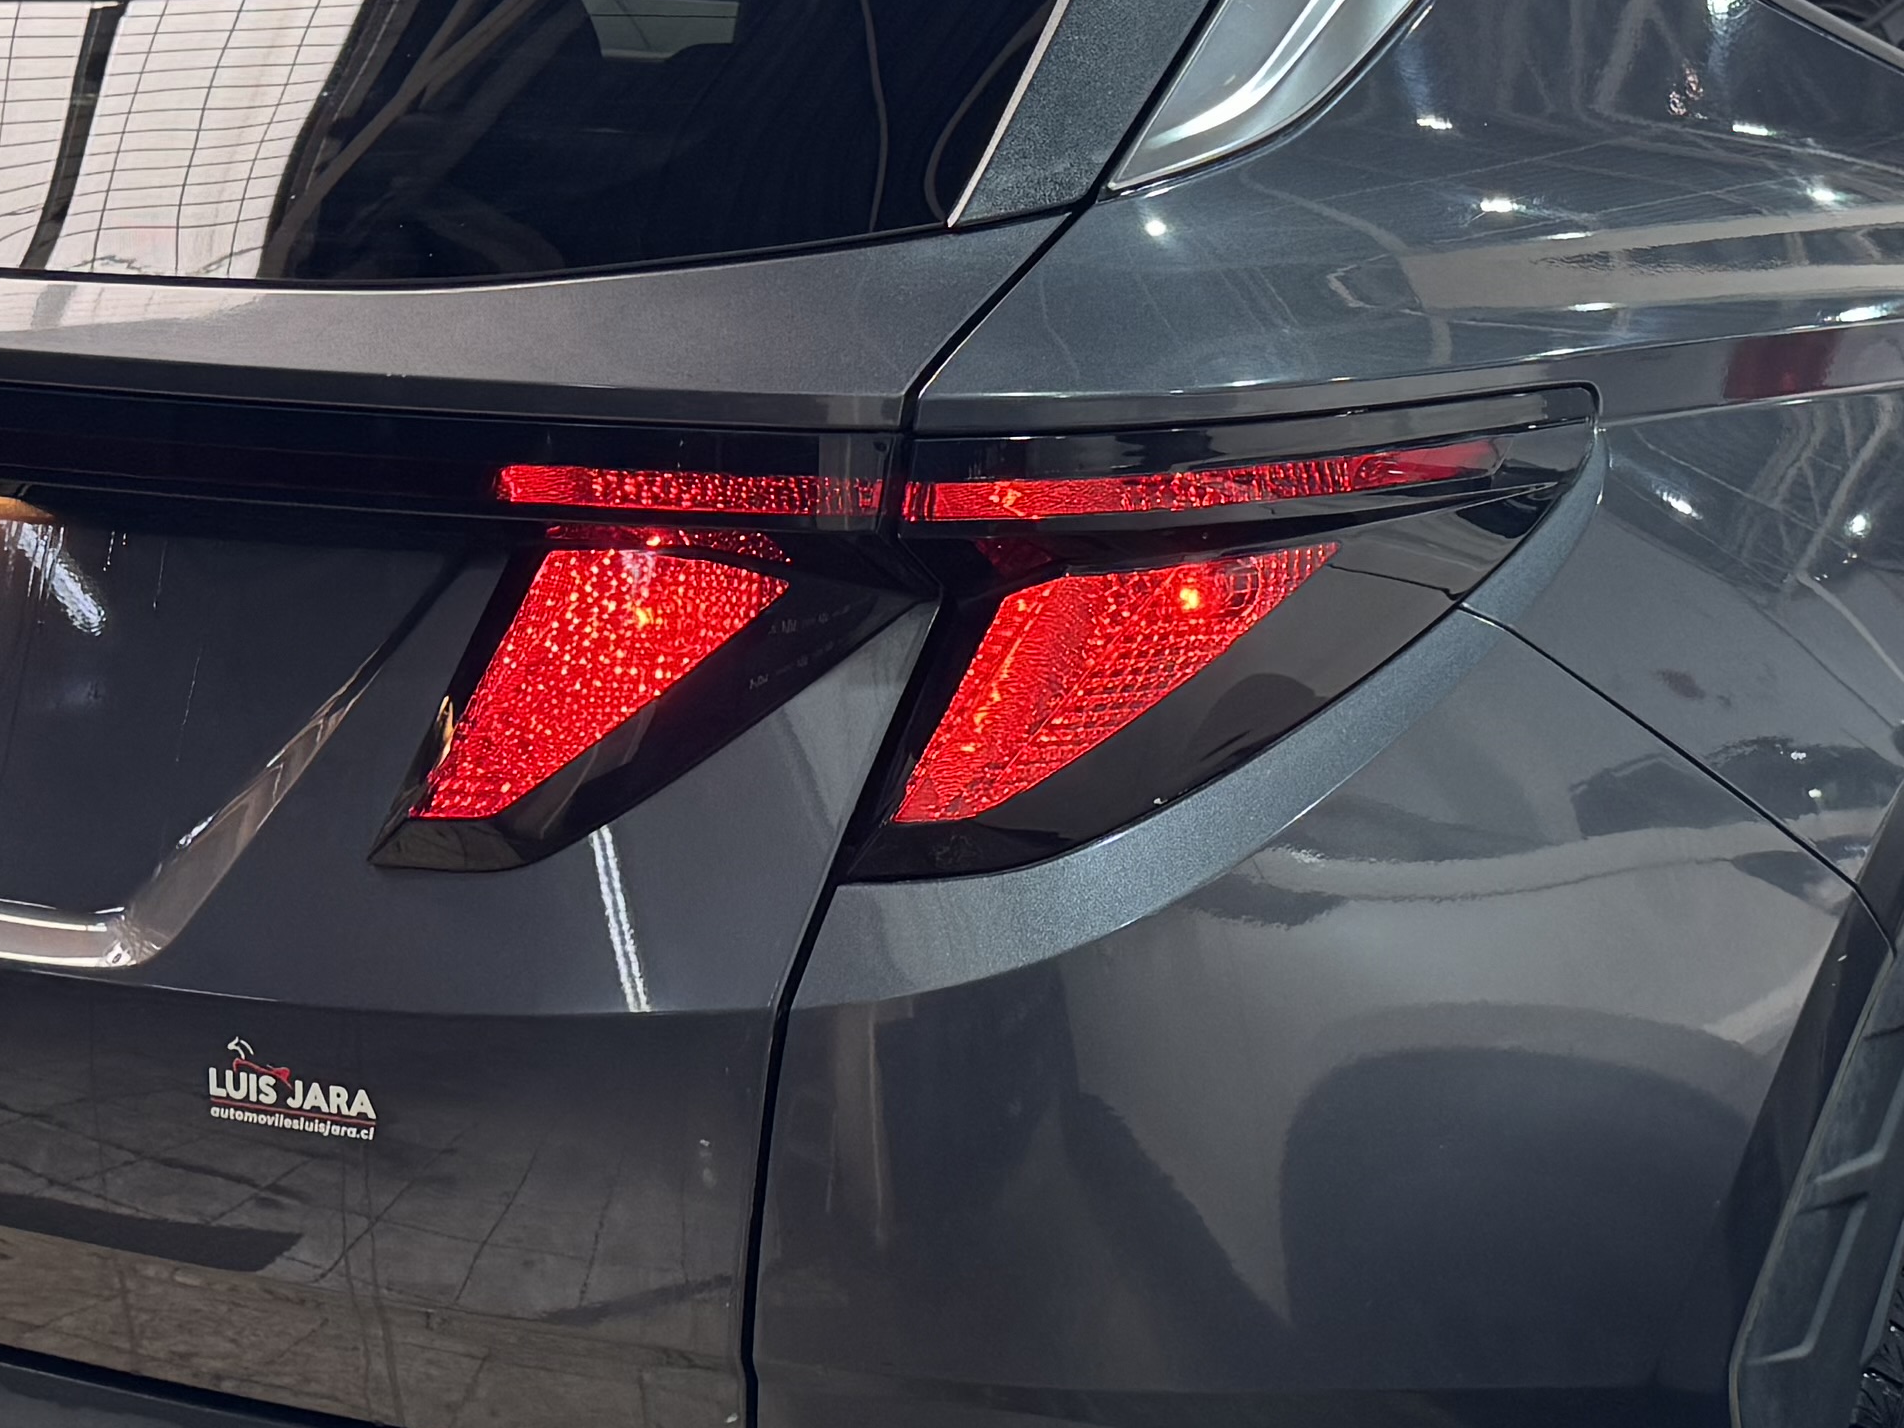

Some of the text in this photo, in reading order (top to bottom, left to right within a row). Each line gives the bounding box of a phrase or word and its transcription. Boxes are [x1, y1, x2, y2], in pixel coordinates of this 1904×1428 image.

[208, 1067, 378, 1120] LUIS JARA
[210, 1105, 375, 1141] automovilesluisjara.cl
